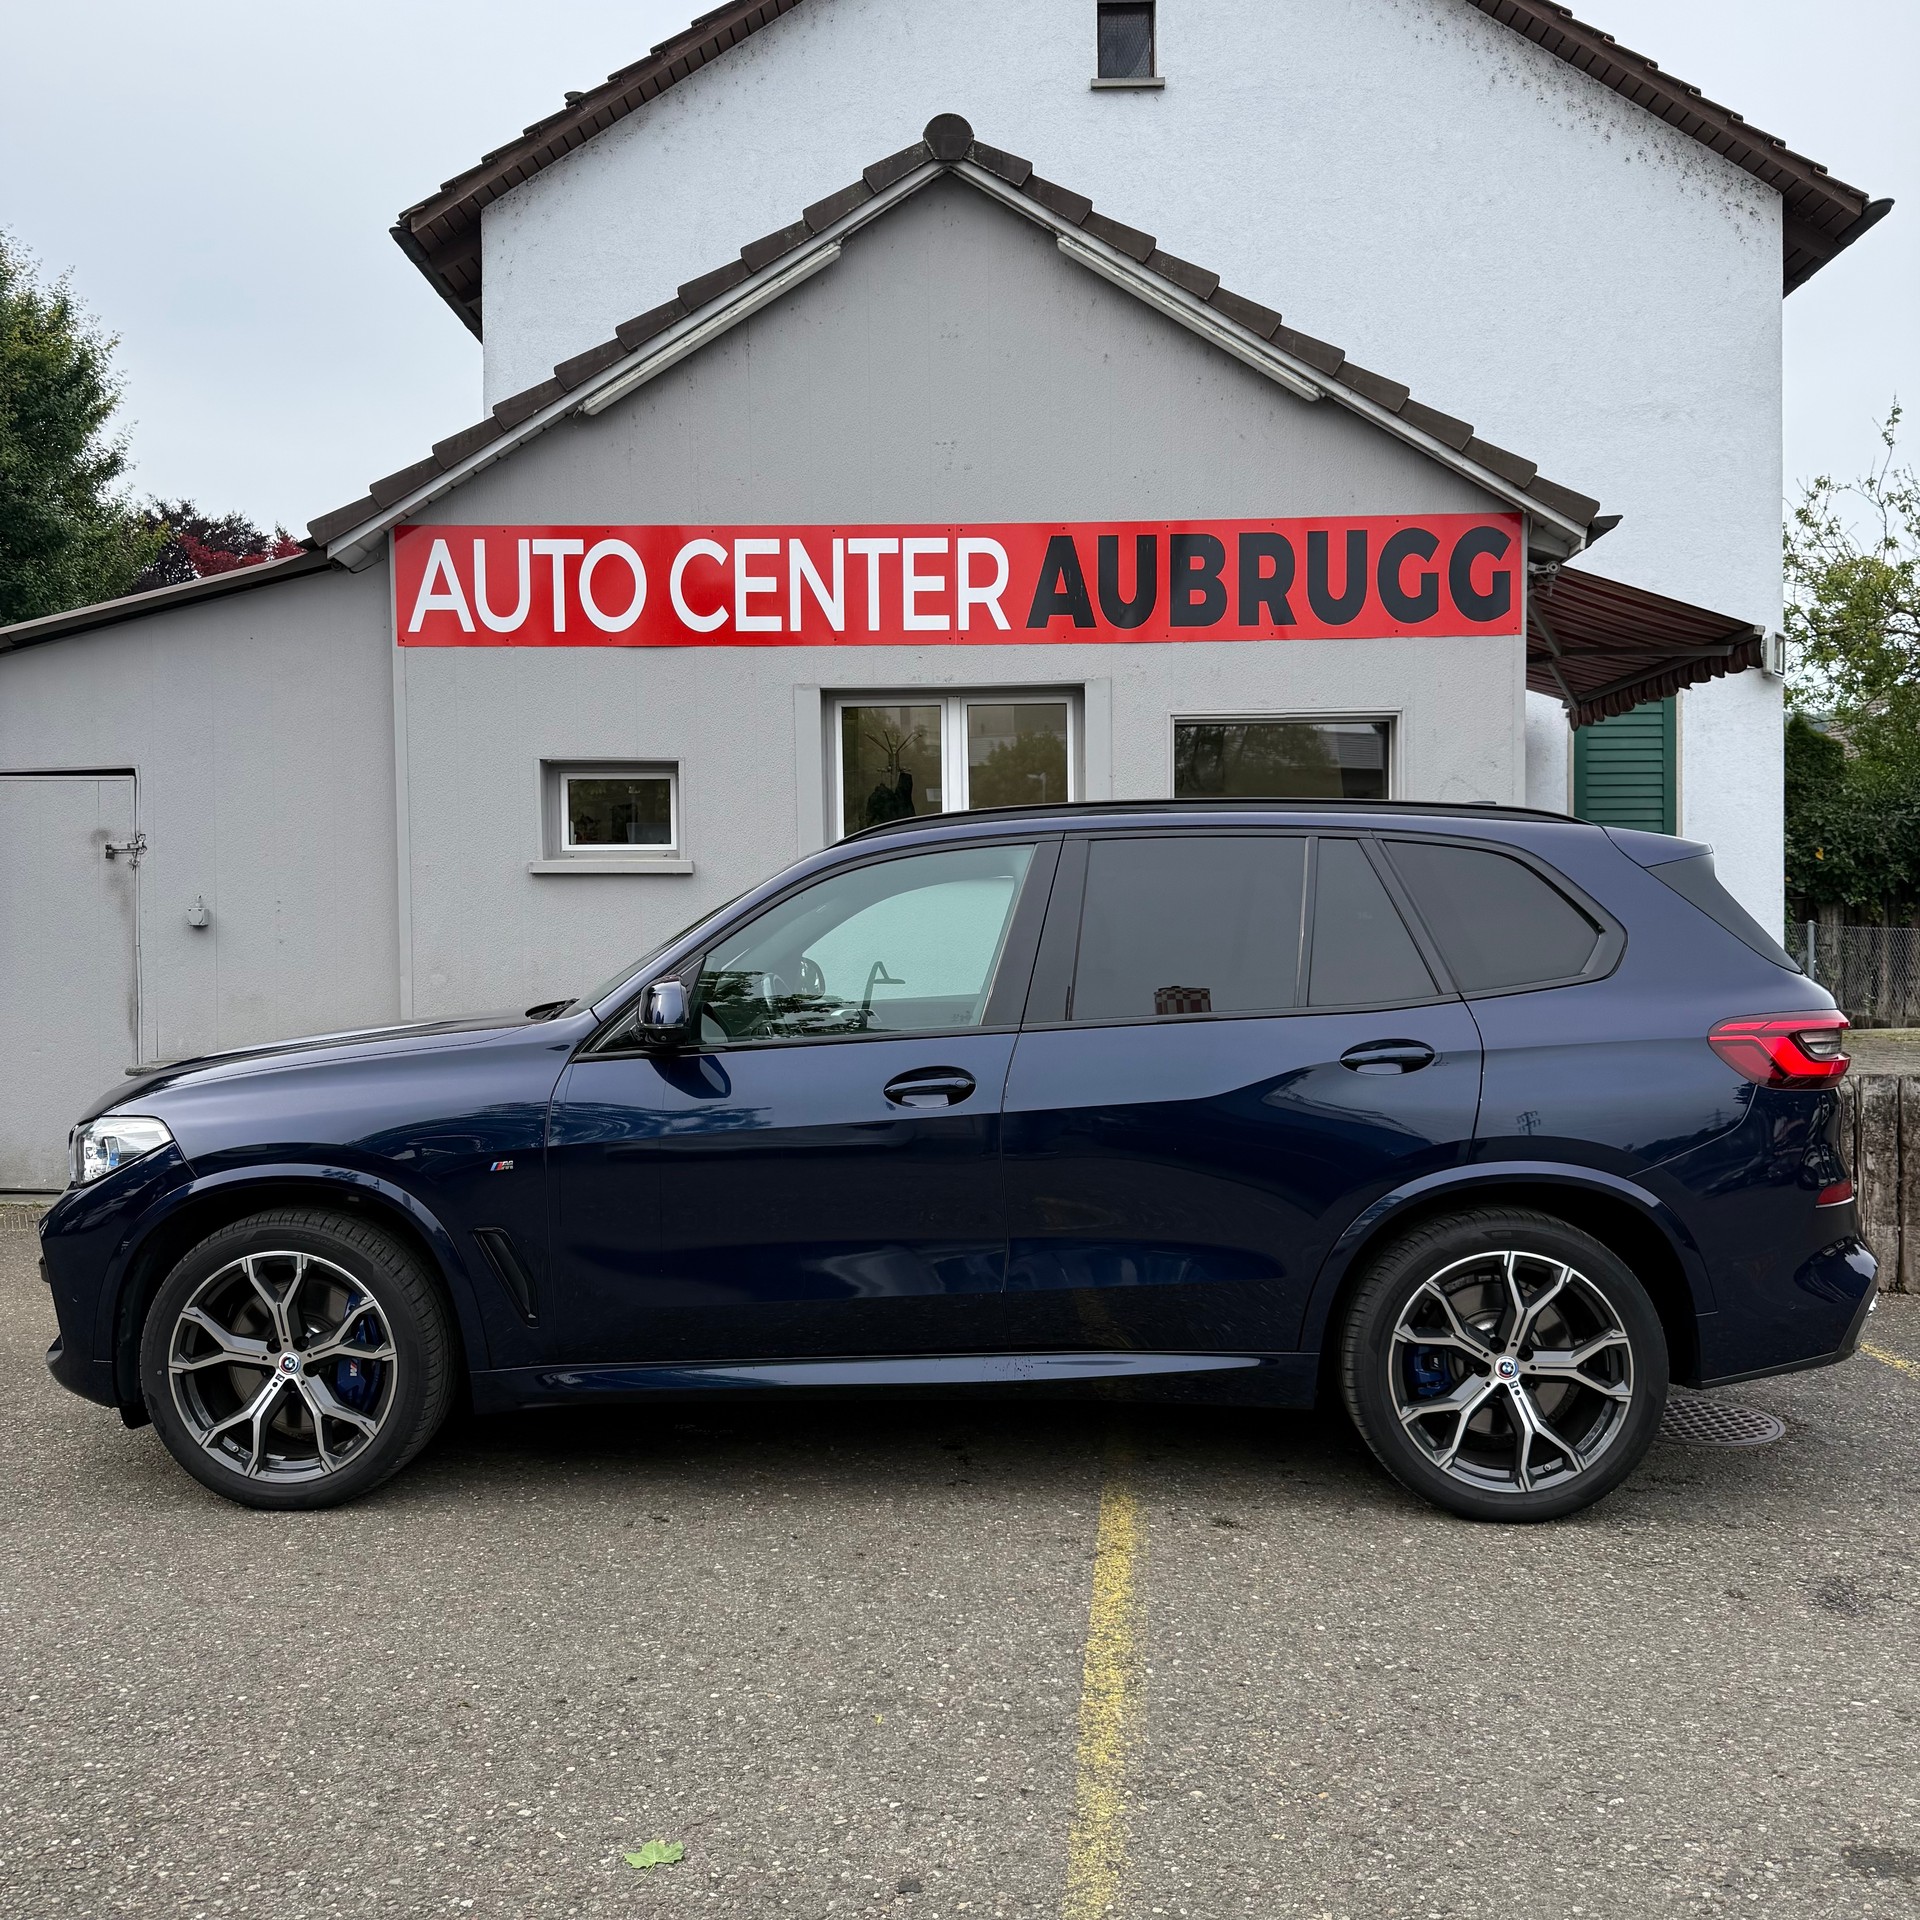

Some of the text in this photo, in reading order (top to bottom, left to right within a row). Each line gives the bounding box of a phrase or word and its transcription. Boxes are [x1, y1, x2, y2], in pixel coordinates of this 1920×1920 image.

[408, 525, 1512, 633] AUTO CENTER AUBRUGG
